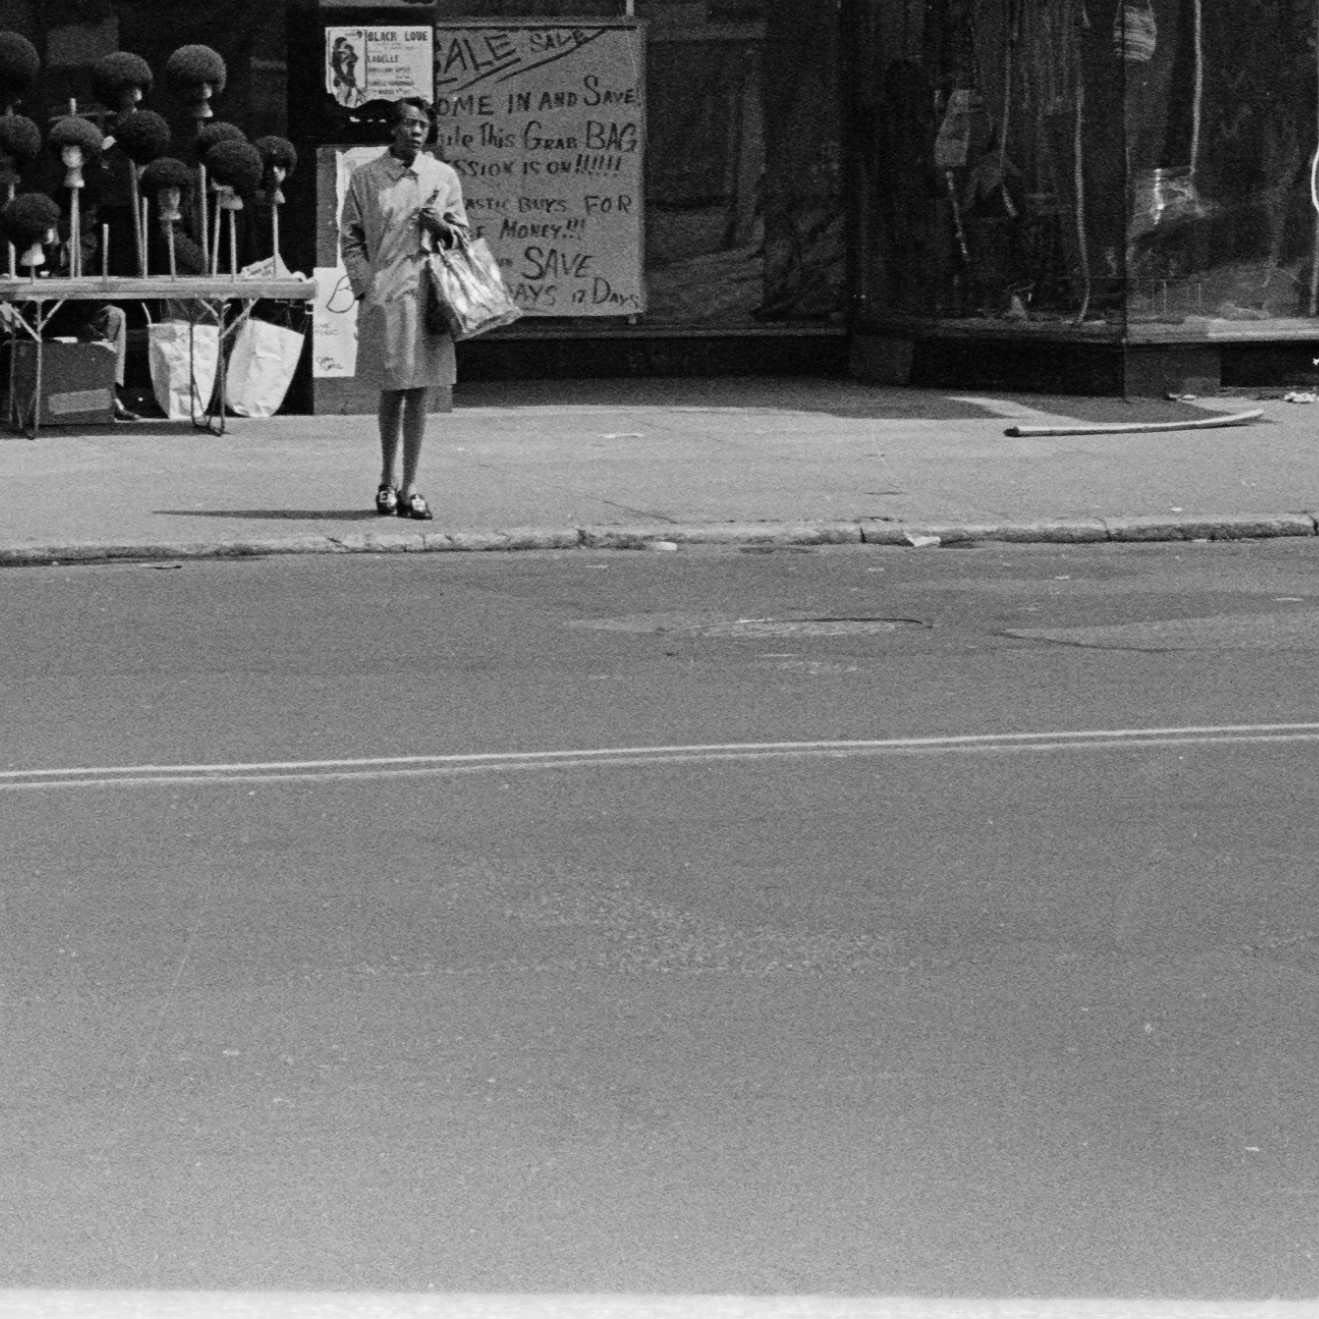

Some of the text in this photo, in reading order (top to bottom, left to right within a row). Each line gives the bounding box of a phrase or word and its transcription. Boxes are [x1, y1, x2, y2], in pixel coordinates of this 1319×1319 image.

[435, 34, 517, 74] ALE
[436, 95, 495, 117] OME
[508, 91, 532, 115] IN
[584, 195, 632, 215] FOR
[522, 246, 596, 280] SAVE
